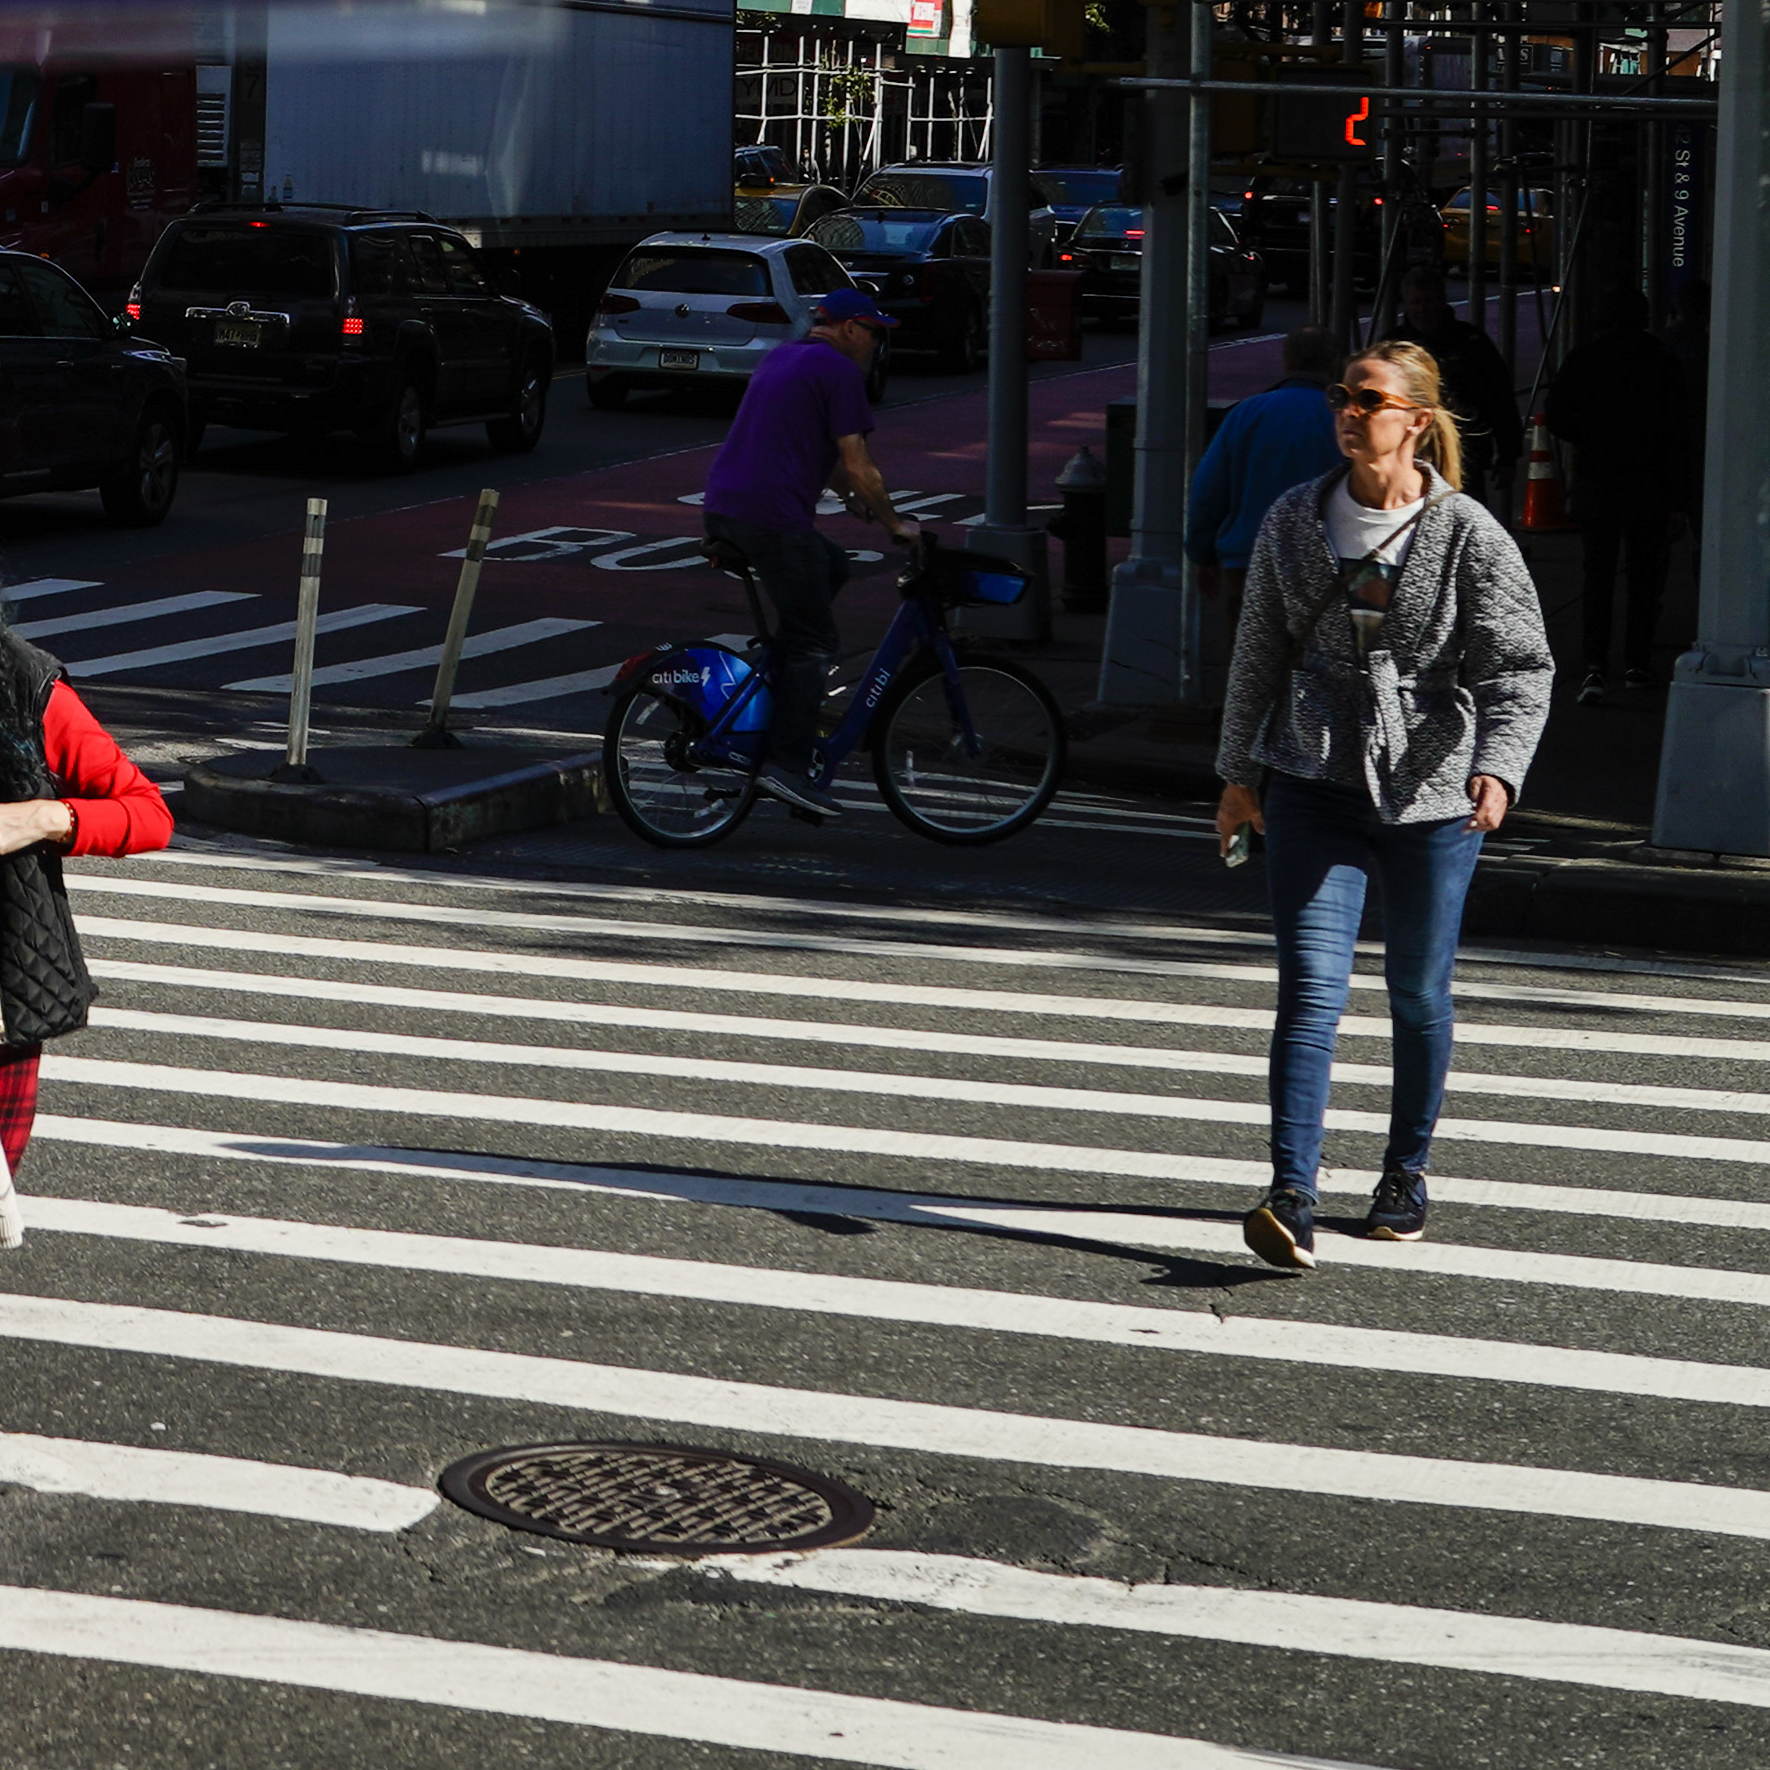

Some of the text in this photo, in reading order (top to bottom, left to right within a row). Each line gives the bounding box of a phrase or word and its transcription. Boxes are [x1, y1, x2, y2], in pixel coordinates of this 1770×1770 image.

[1674, 149, 1691, 168] St
[1674, 172, 1690, 184] &
[1674, 189, 1690, 201] 9
[1671, 204, 1690, 268] Avenue
[652, 668, 700, 685] citi bike
